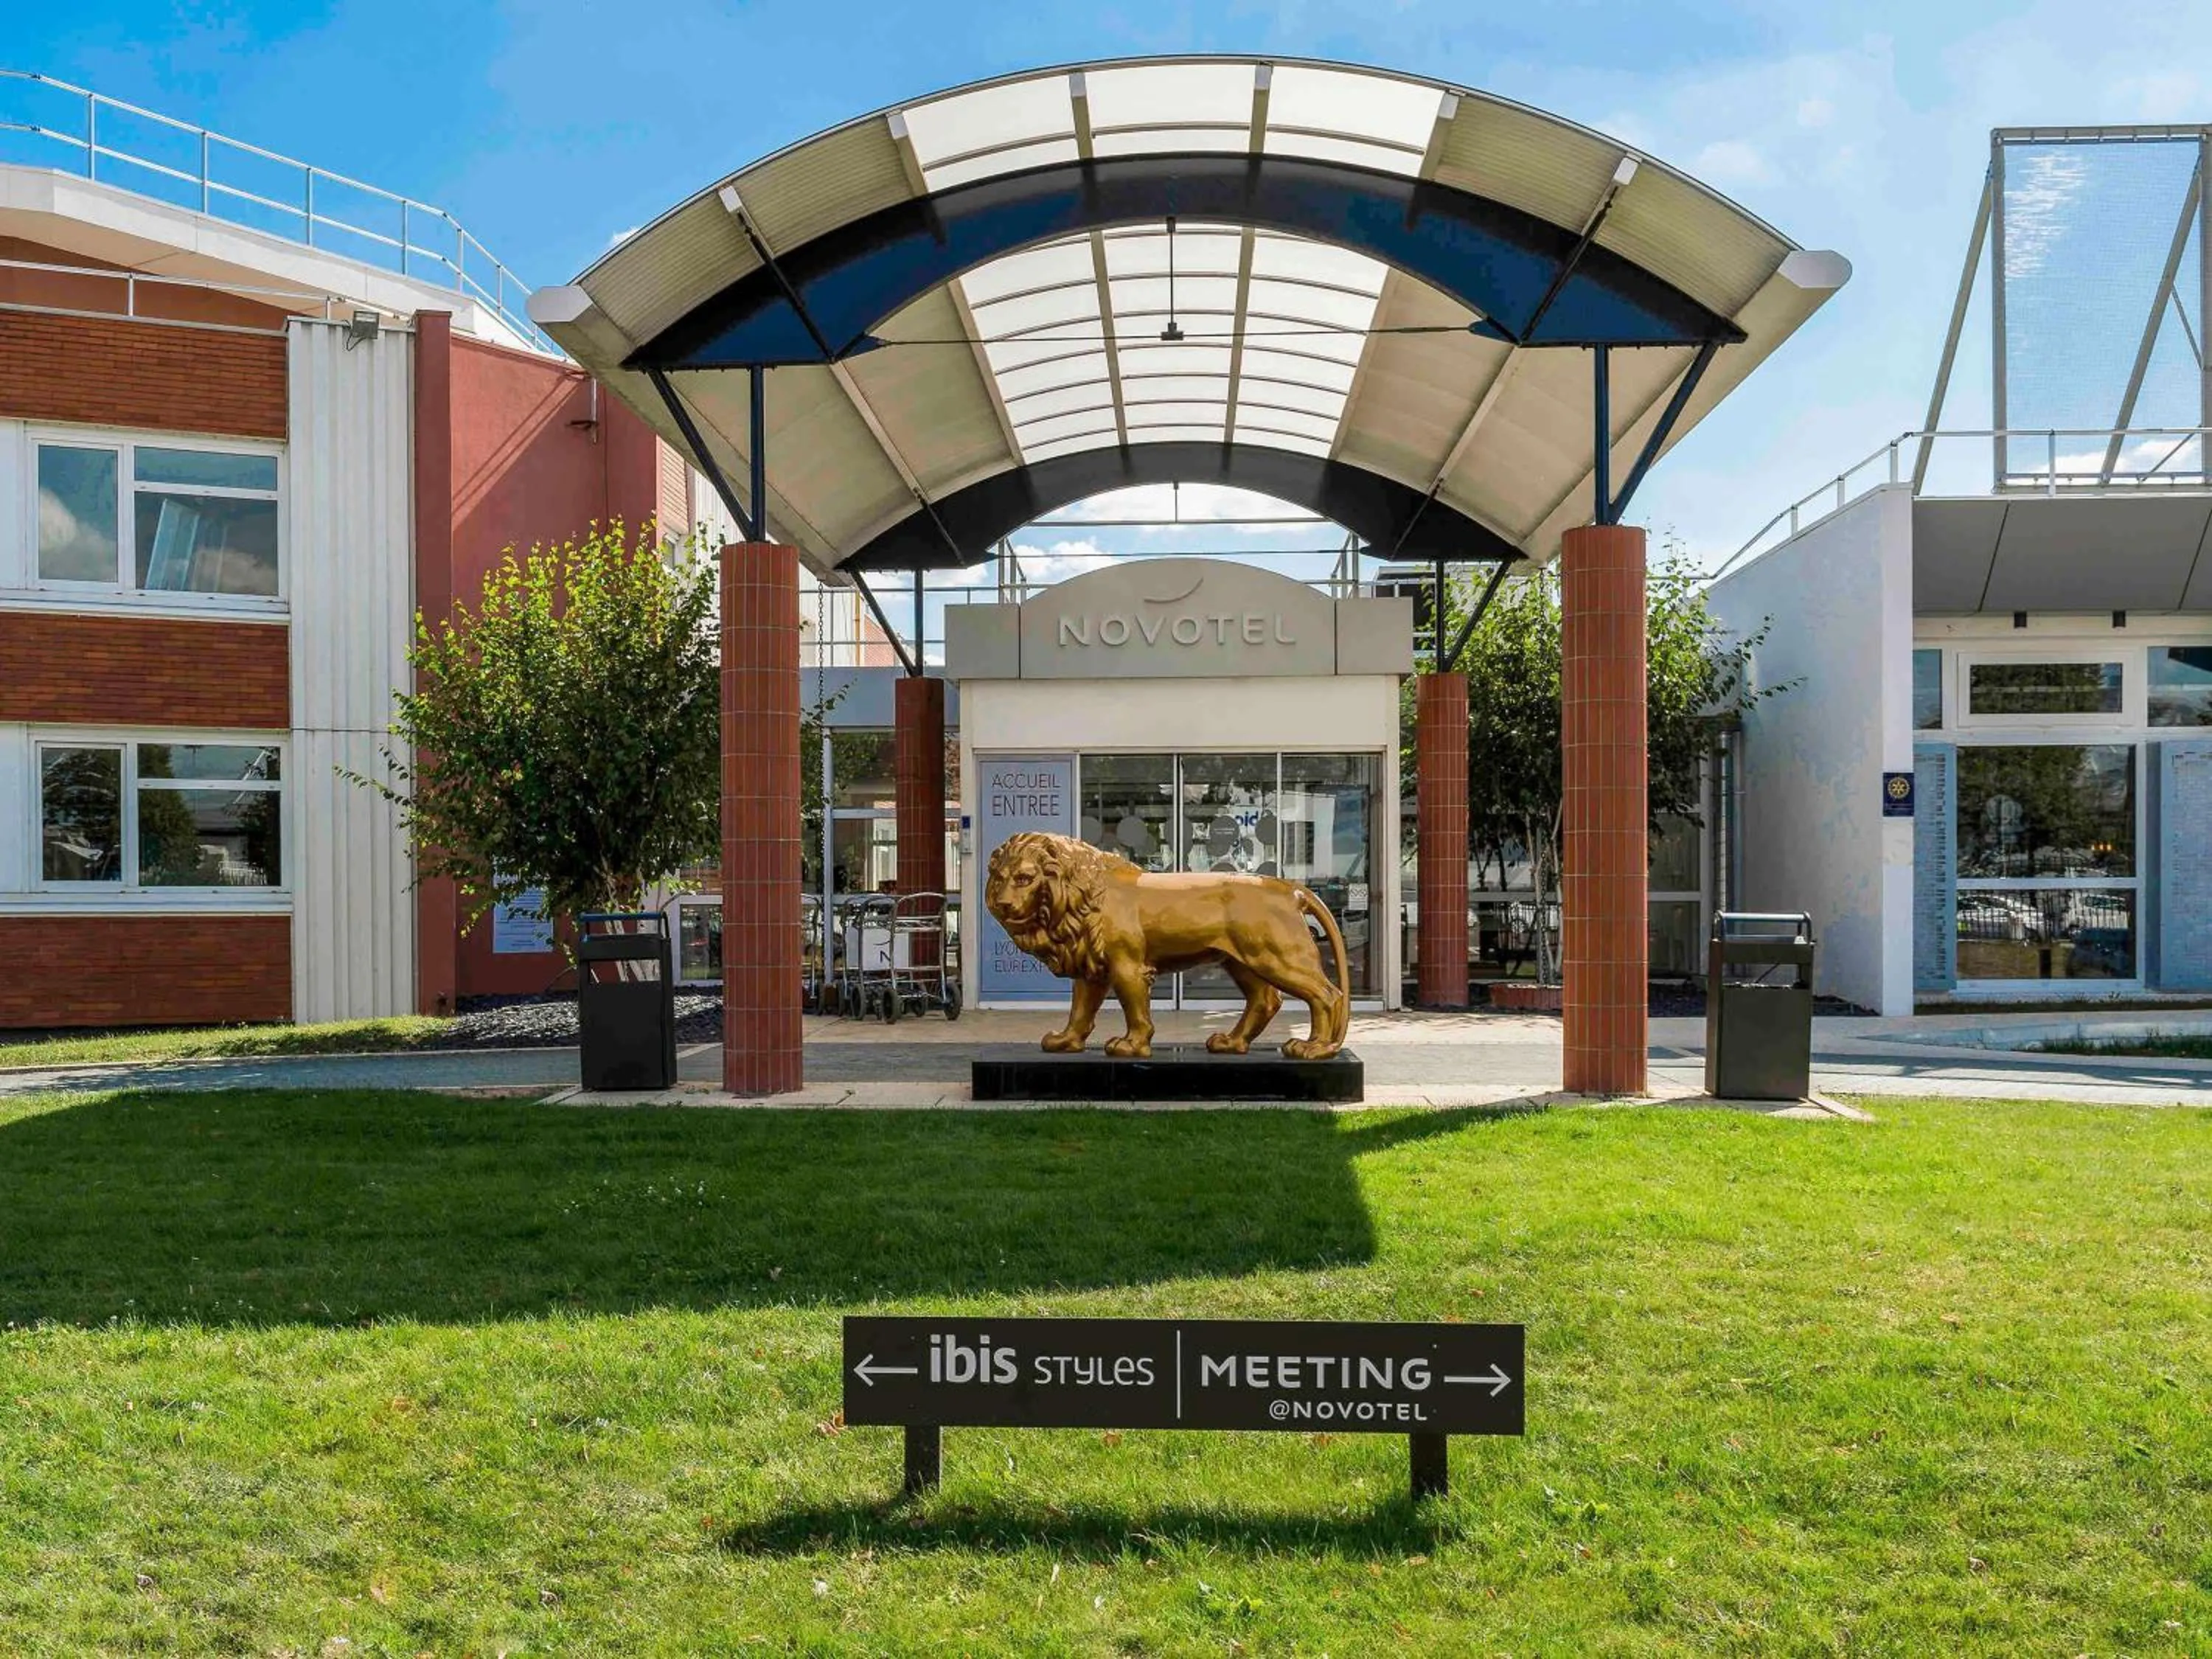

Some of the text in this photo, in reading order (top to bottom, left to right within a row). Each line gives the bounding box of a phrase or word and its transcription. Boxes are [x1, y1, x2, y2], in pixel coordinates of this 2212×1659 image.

[1058, 613, 1296, 647] NOVOTEL
[992, 773, 1061, 789] ACCUEIL
[992, 795, 1060, 816] ENTREE
[994, 941, 1018, 956] LYO
[930, 1335, 1018, 1384] ibis
[1200, 1354, 1432, 1391] MEETING
[1269, 1400, 1427, 1421] @NOVOTEL
